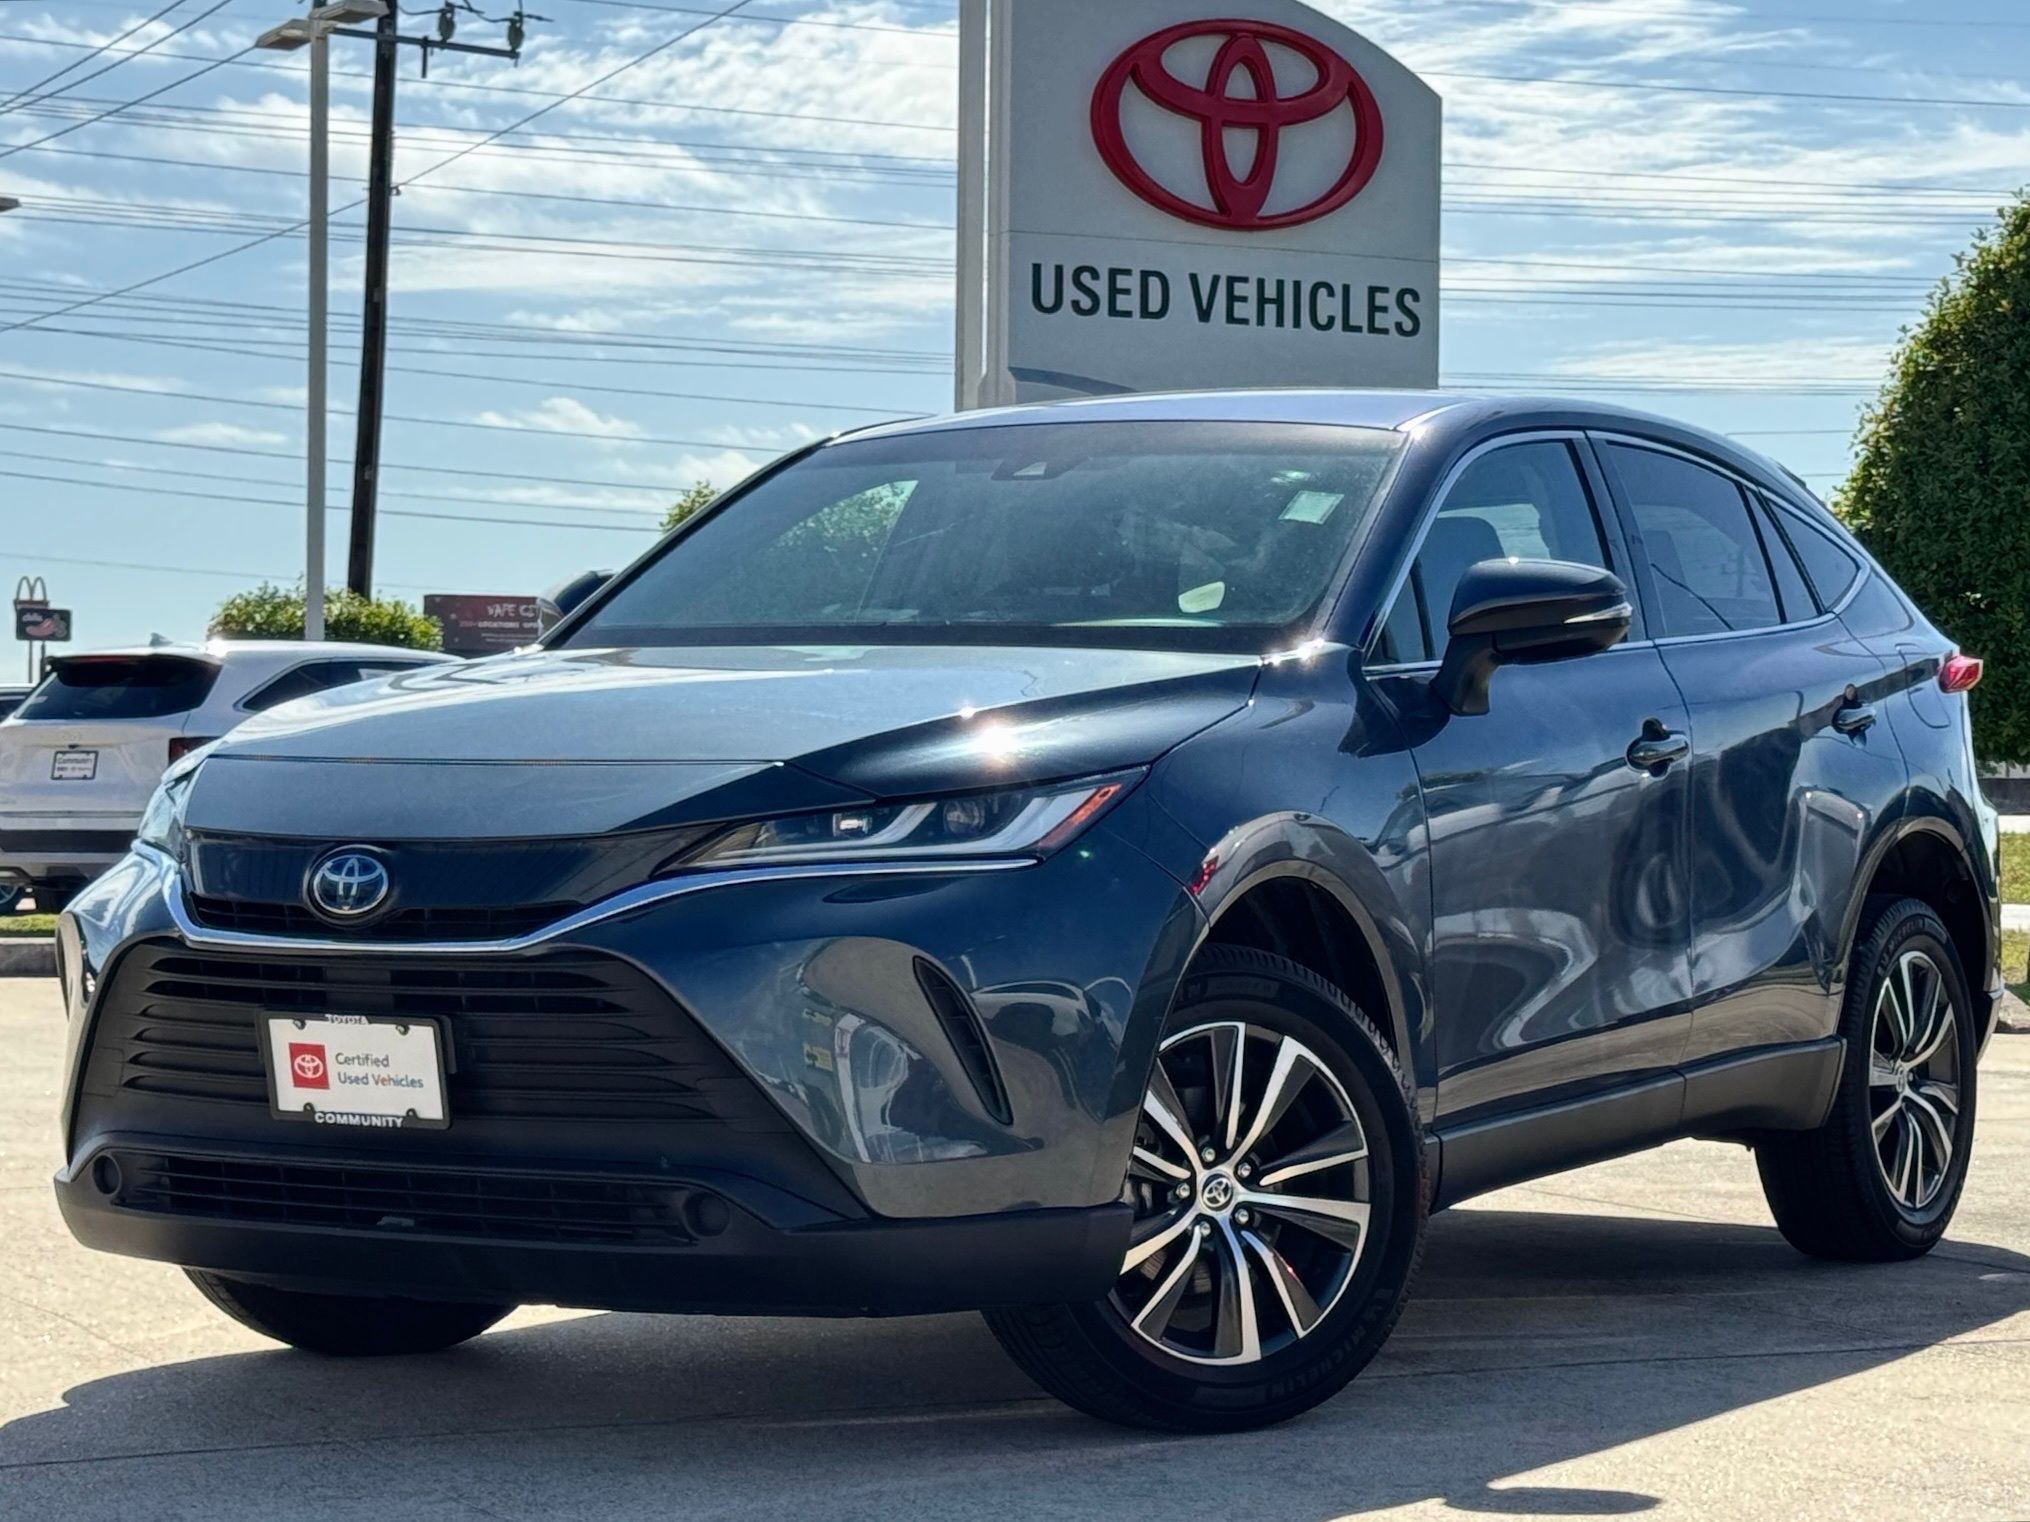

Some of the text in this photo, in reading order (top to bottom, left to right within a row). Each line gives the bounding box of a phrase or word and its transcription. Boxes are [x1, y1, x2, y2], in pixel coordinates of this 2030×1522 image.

[1031, 262, 1421, 338] USED VEHICLES
[335, 1052, 390, 1068] Certified
[338, 1072, 424, 1089] Used Vehicles
[314, 1111, 404, 1128] COMMUNITY
